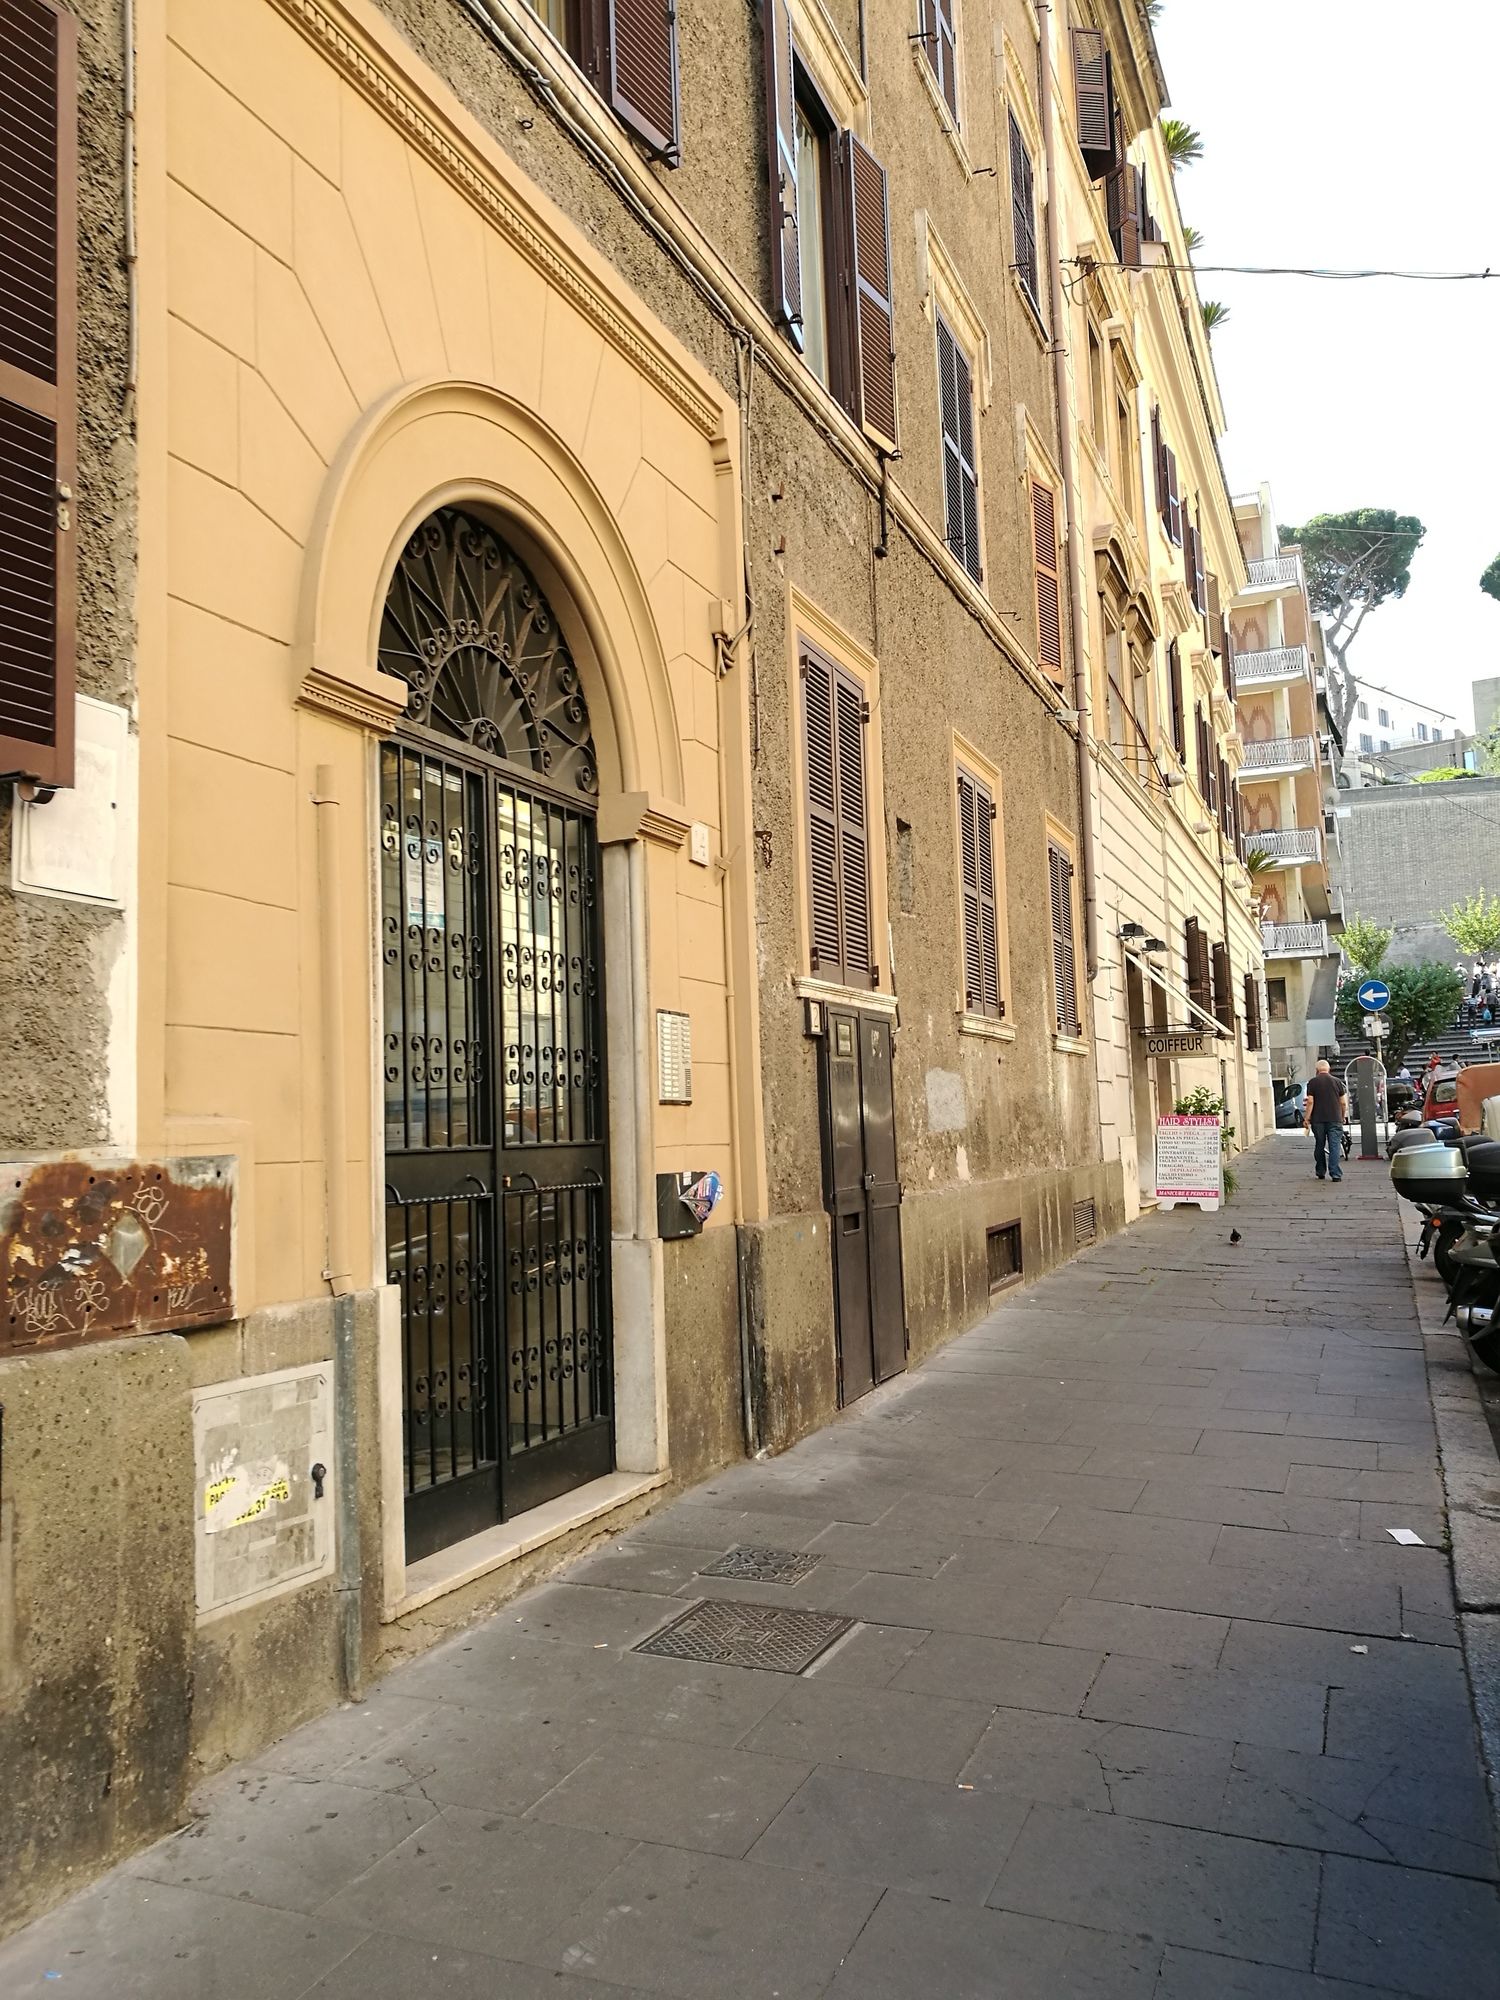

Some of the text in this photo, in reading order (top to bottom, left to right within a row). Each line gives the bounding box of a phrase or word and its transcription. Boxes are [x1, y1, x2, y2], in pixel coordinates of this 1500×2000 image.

[1148, 1037, 1203, 1053] COIFFEUR
[1160, 1117, 1218, 1126] HAIR STYLIST
